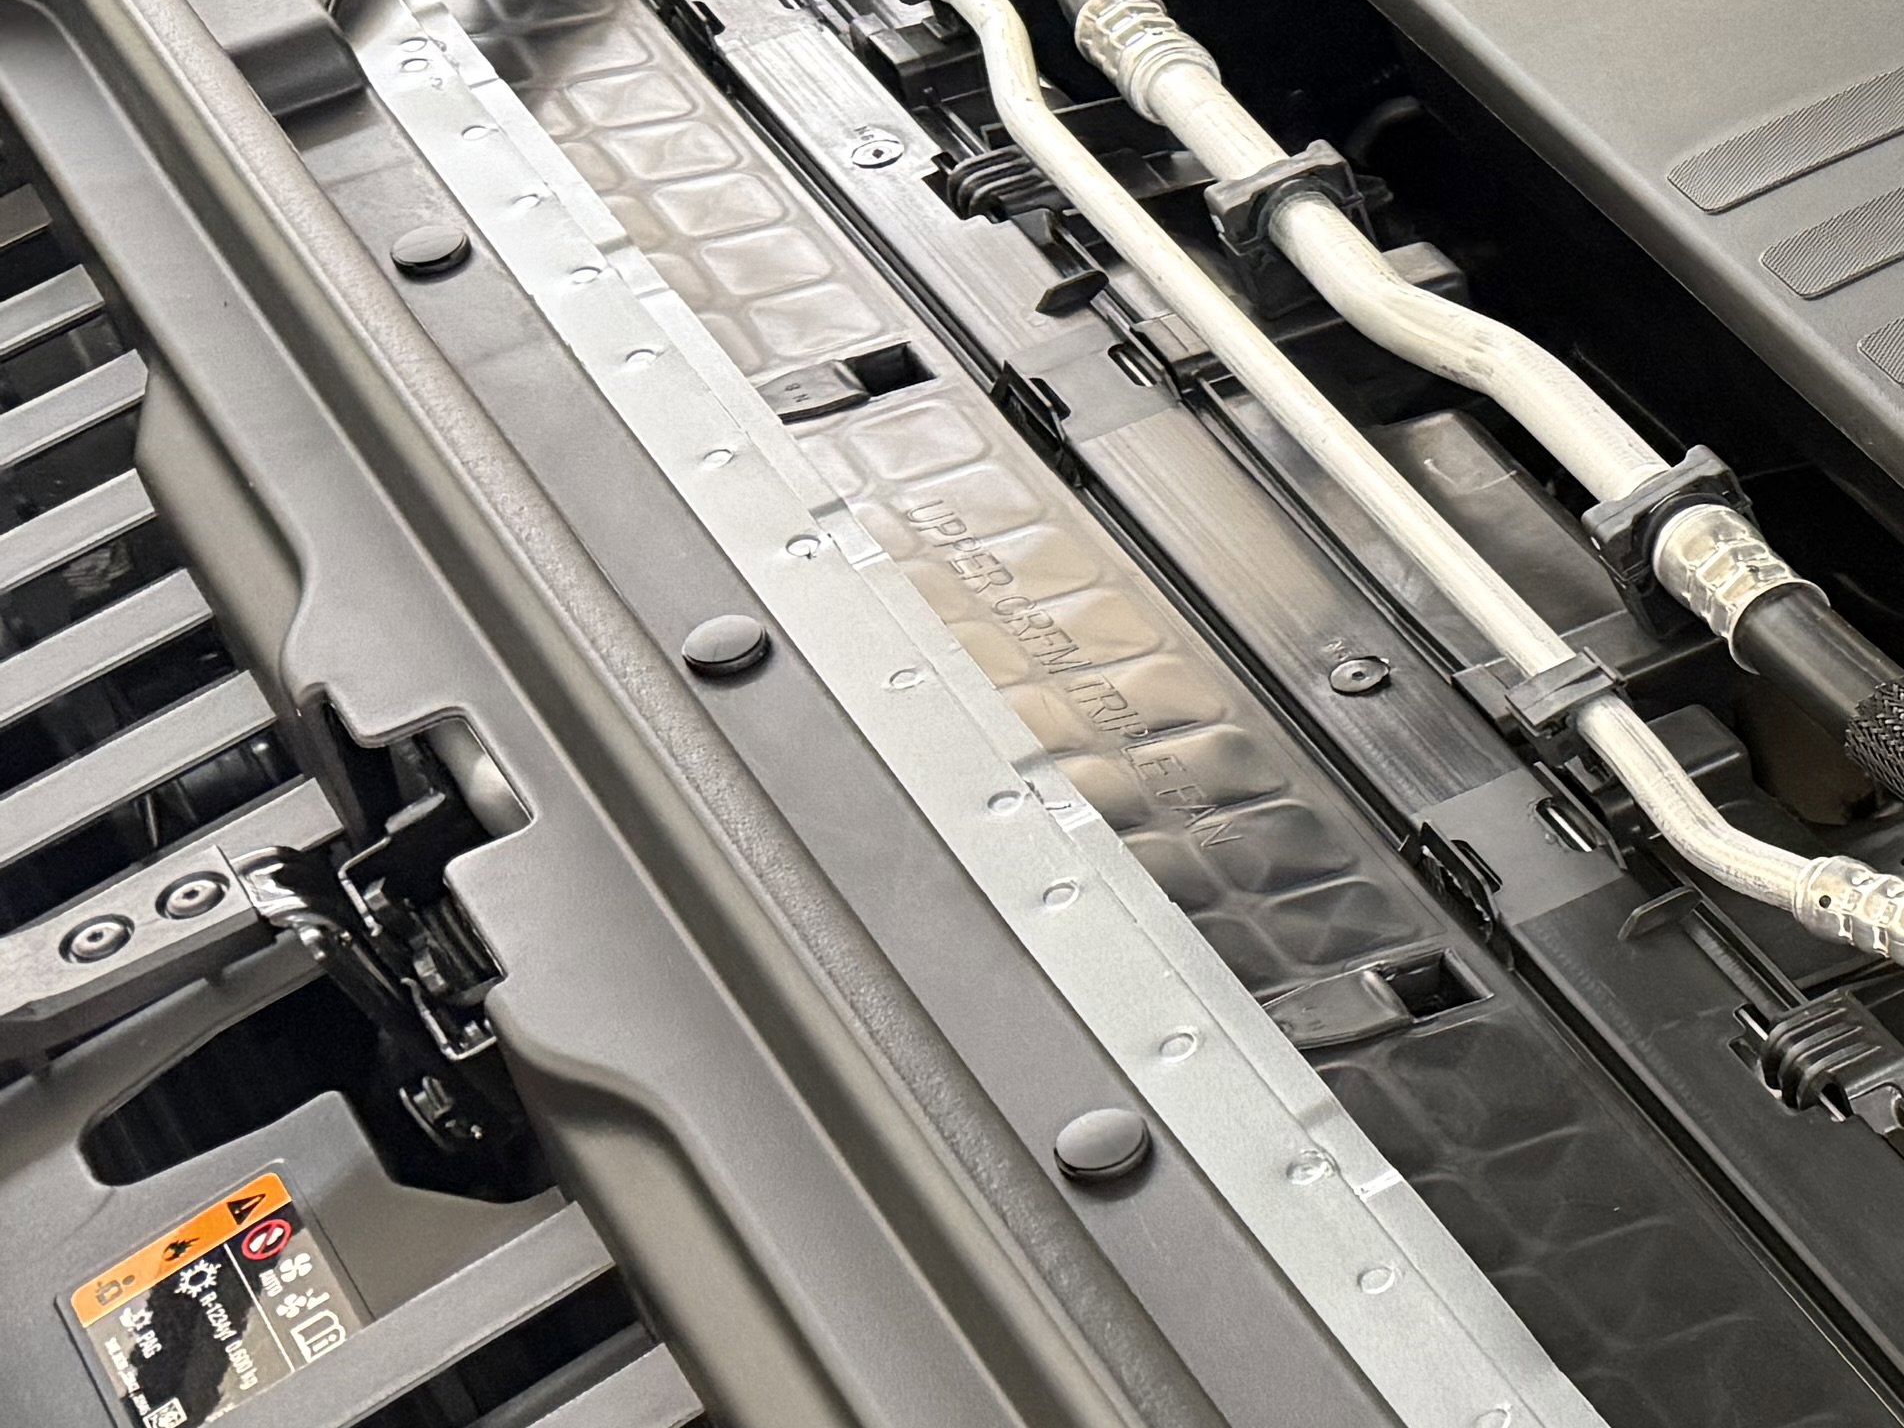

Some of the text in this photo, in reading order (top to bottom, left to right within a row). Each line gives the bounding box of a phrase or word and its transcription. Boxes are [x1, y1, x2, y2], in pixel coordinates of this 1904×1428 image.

[904, 496, 1244, 848] UPPER CRFM TRIPLE FAN
[258, 1267, 284, 1298] AUTO
[134, 1330, 163, 1359] PAG
[239, 1367, 258, 1391] kg
